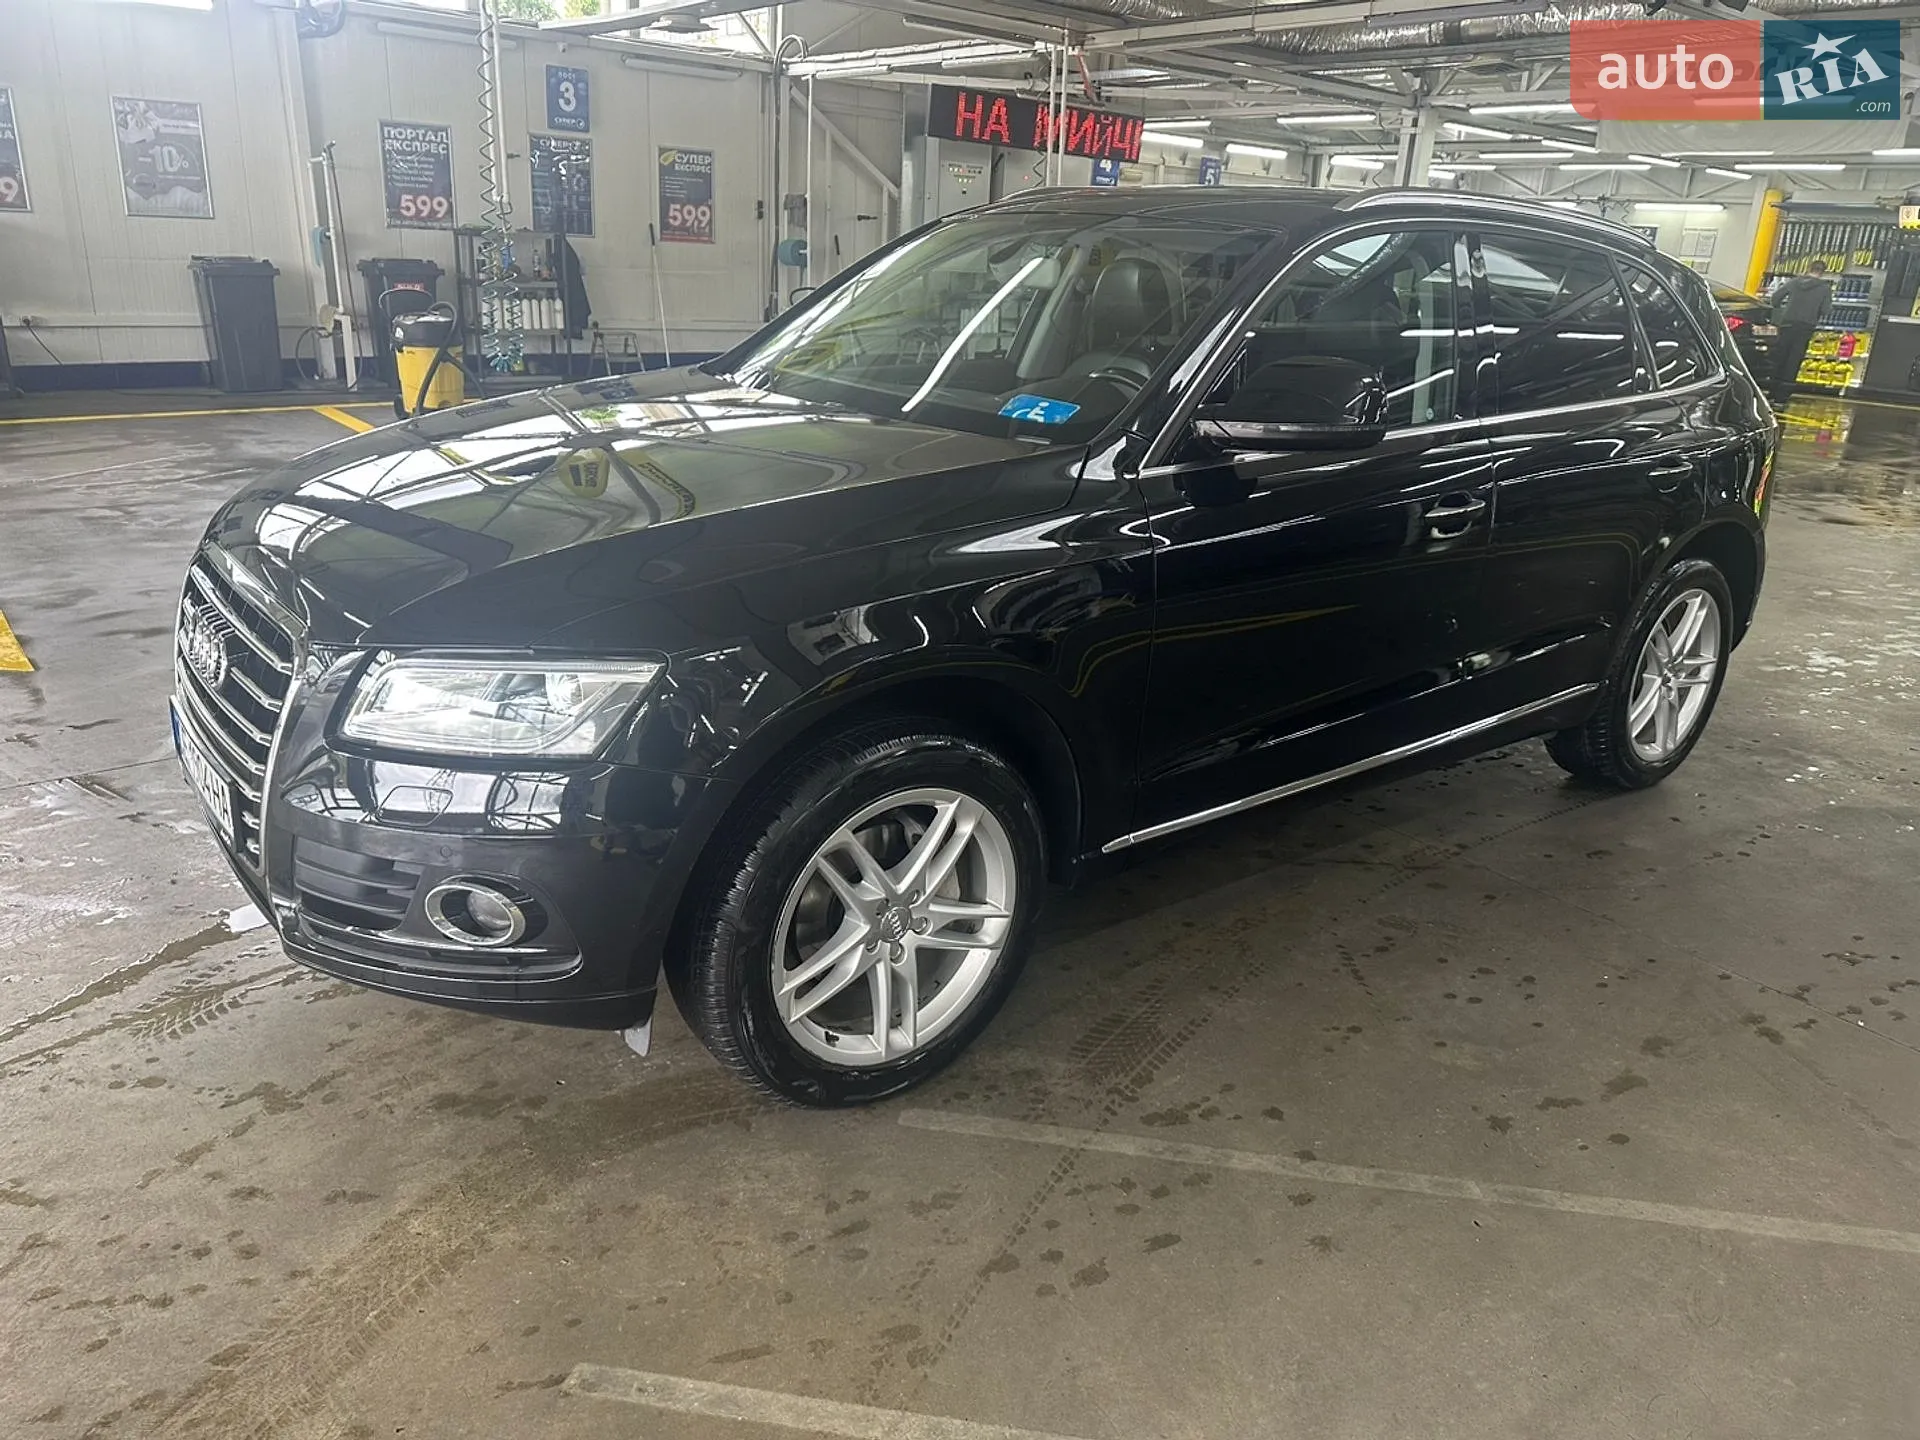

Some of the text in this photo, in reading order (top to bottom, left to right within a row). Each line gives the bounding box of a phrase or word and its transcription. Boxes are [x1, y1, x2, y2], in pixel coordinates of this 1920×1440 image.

[558, 81, 576, 112] 3
[955, 91, 1011, 143] НА
[383, 126, 449, 143] ПОРТАЛ
[384, 139, 448, 154] ЕКСПРЕС
[674, 153, 712, 165] СУПЕР
[400, 194, 449, 218] 599
[668, 203, 711, 228] 599
